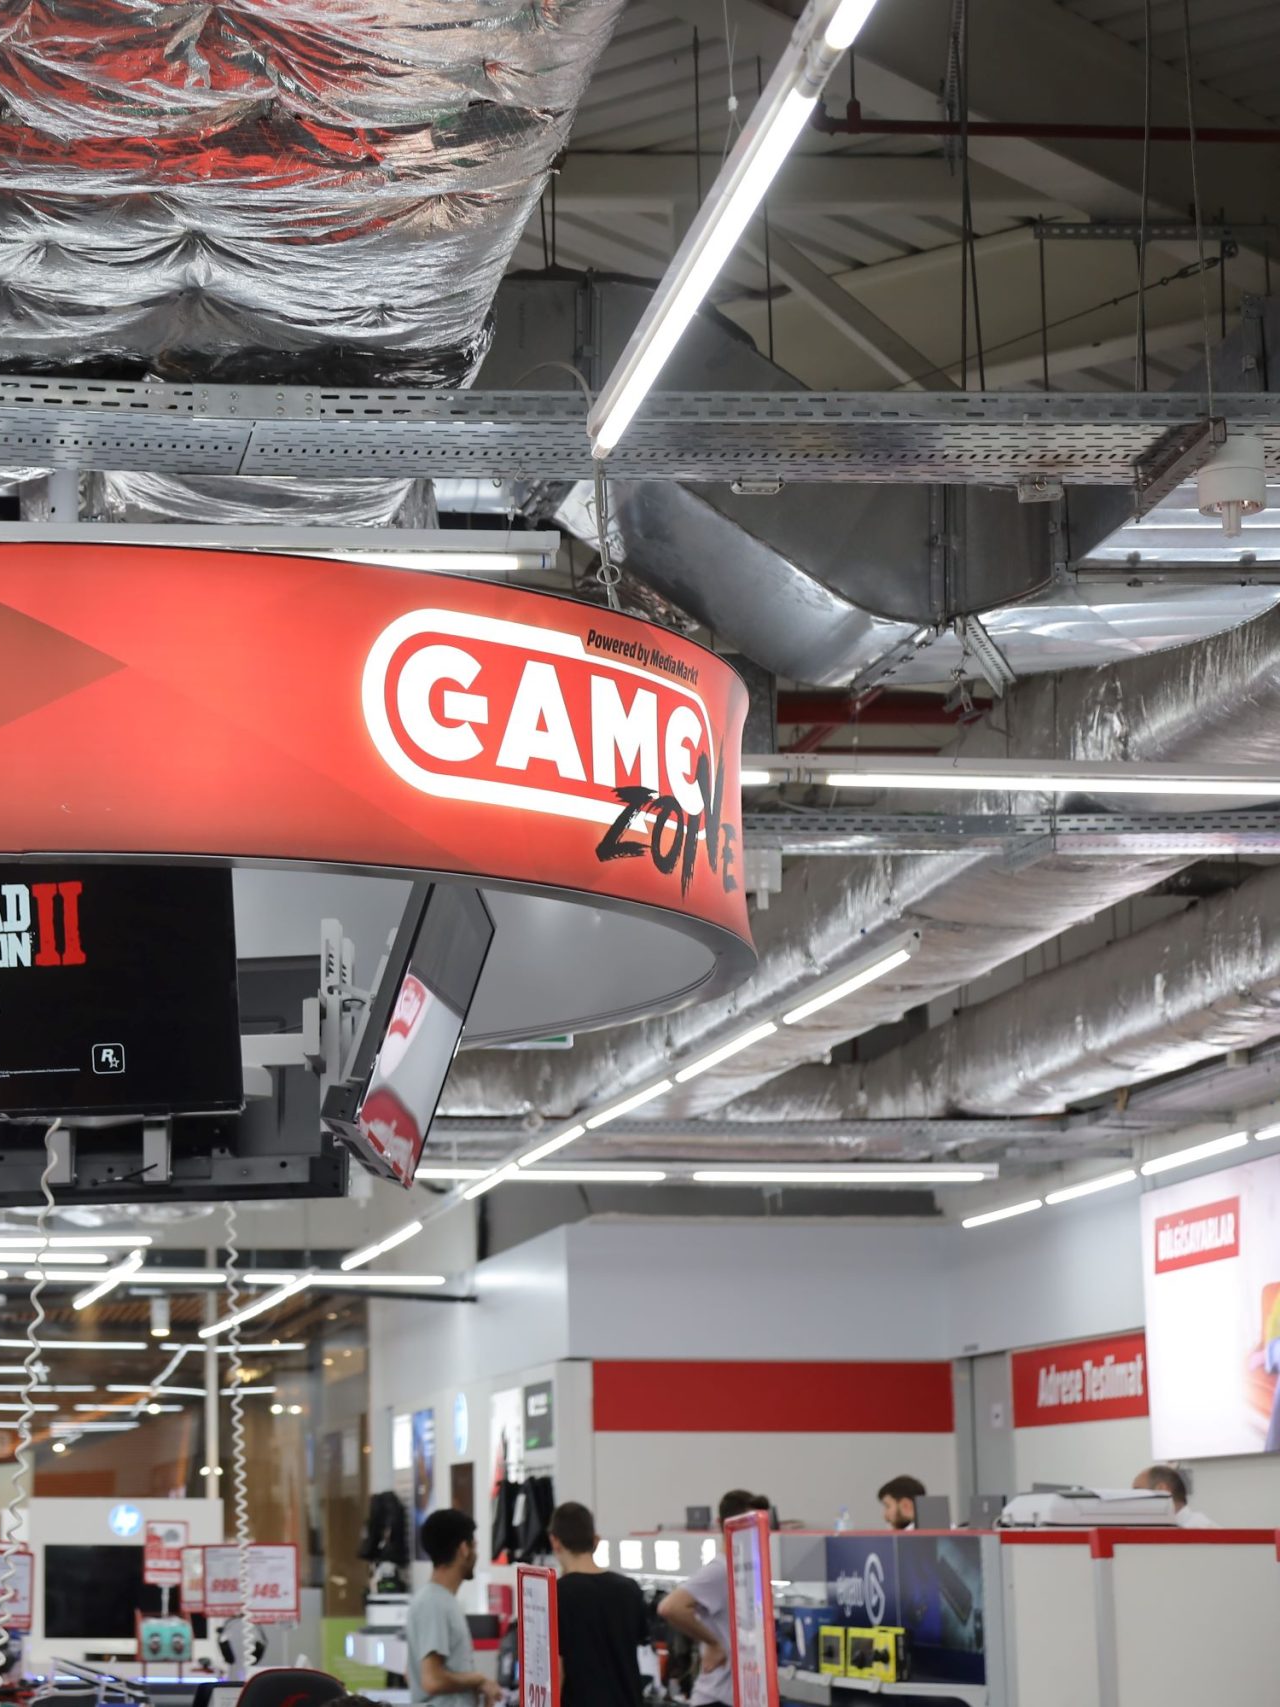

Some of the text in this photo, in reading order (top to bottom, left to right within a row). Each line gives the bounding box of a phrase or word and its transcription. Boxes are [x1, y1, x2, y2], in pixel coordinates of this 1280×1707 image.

[587, 629, 699, 686] Powered by MediaMarkt
[397, 644, 704, 816] GAME
[594, 733, 738, 903] ZONE
[31, 881, 86, 966] II
[1037, 1363, 1083, 1408] Adrese
